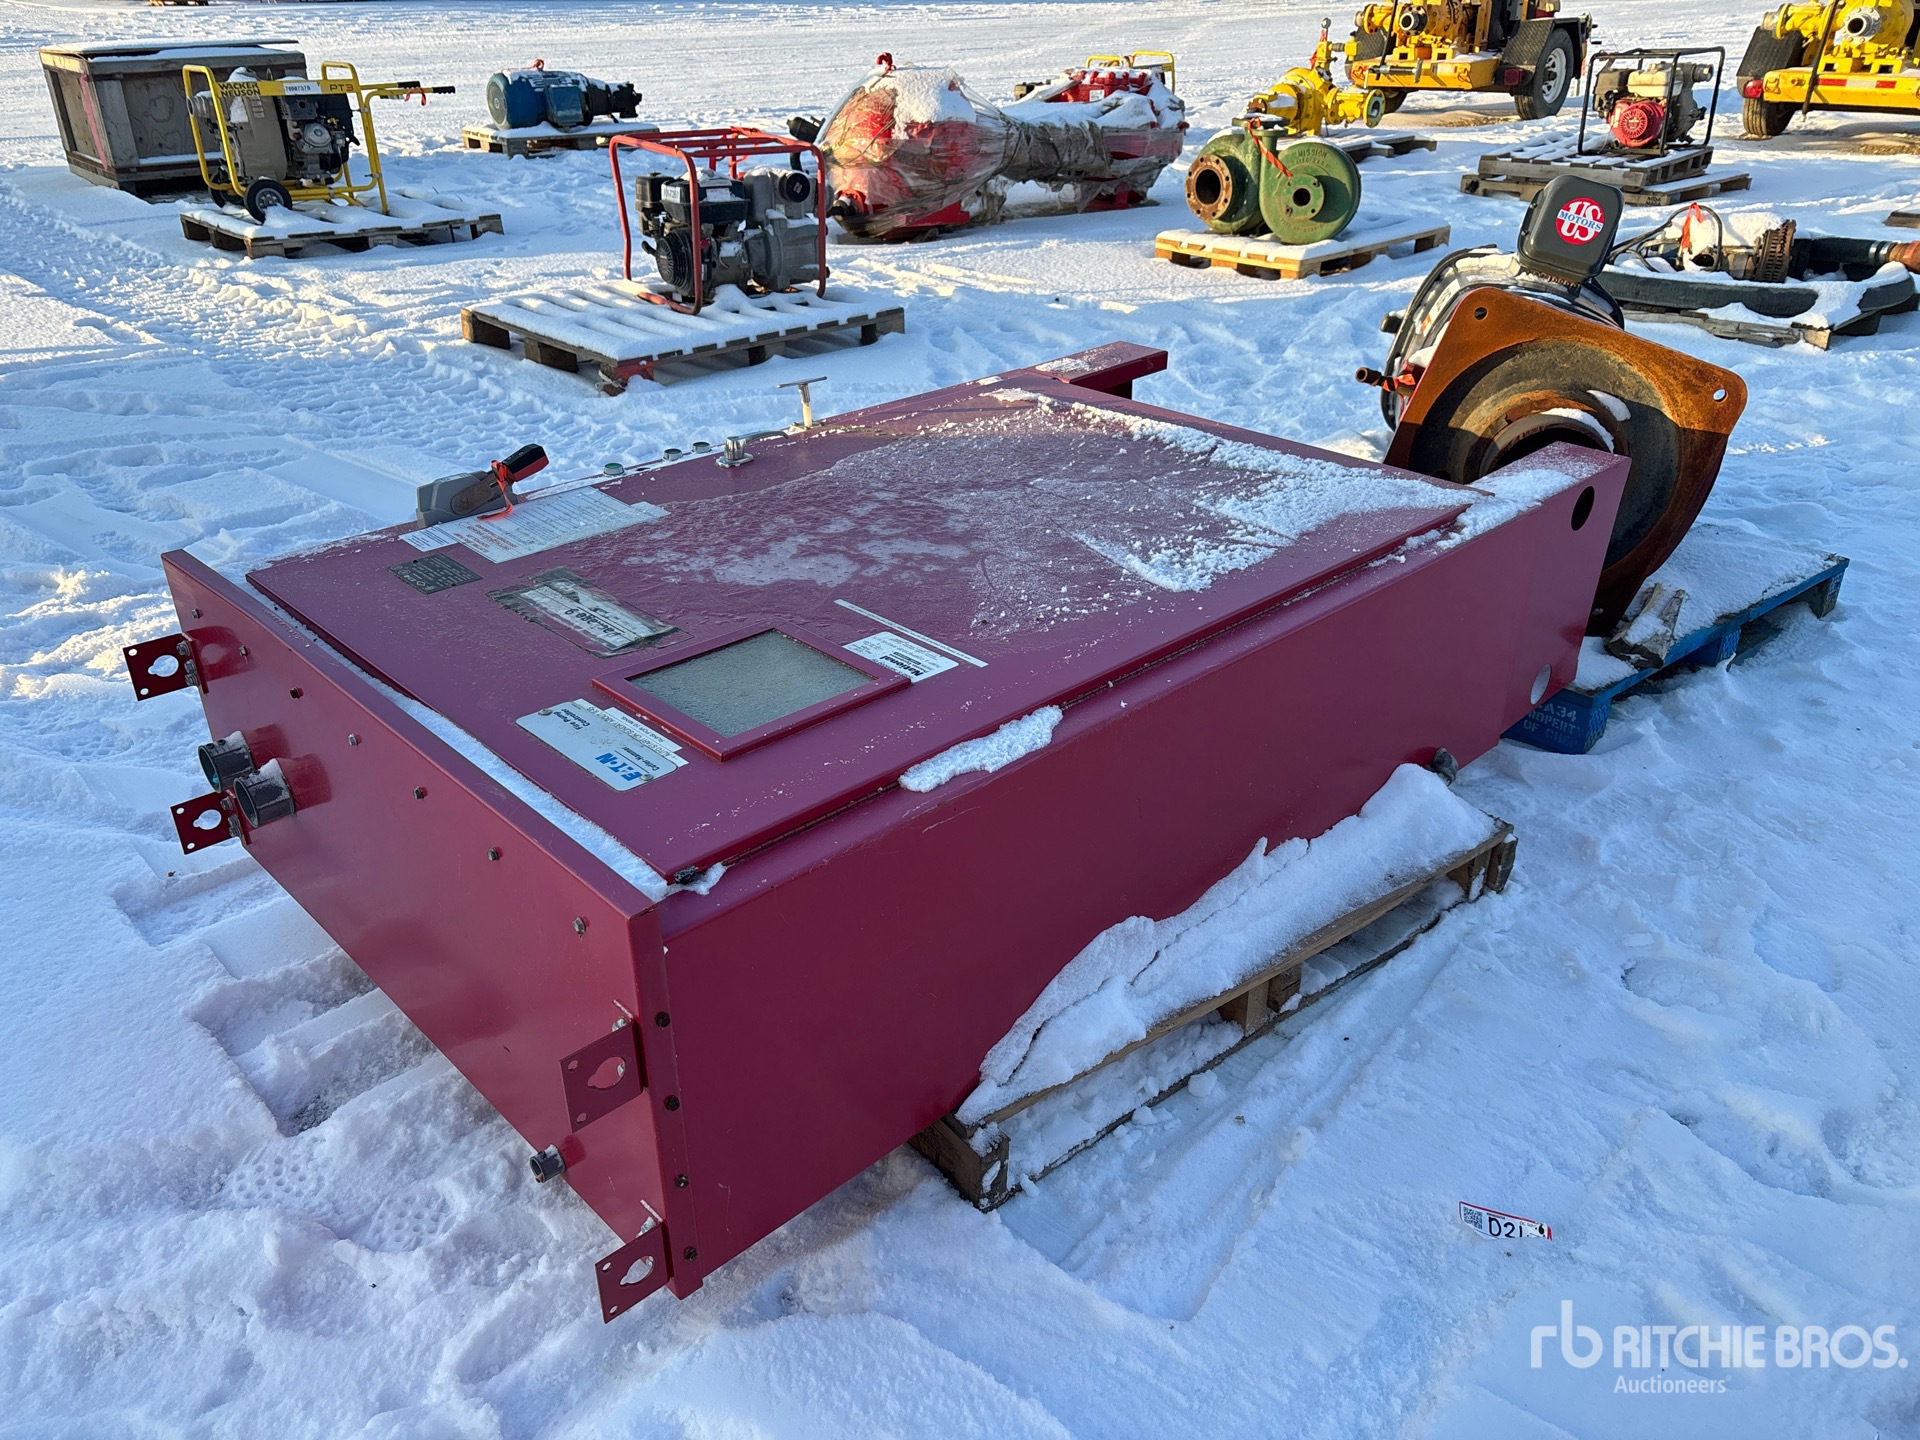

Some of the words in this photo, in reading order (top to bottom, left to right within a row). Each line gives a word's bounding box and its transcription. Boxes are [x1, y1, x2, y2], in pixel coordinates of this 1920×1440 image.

[218, 82, 258, 91] WACKER
[220, 89, 261, 97] NEUSON
[330, 84, 354, 92] PT3
[1297, 149, 1328, 159] MISSION
[1559, 211, 1602, 231] MOTORS
[1561, 201, 1602, 241] US
[879, 655, 924, 677] National
[553, 711, 572, 724] Pump
[561, 708, 591, 727] Controller
[1540, 703, 1577, 722] A34
[569, 719, 584, 731] Fire
[1523, 720, 1540, 732] OF
[595, 753, 643, 781] EATON
[622, 746, 660, 772] Cutler-Hammer
